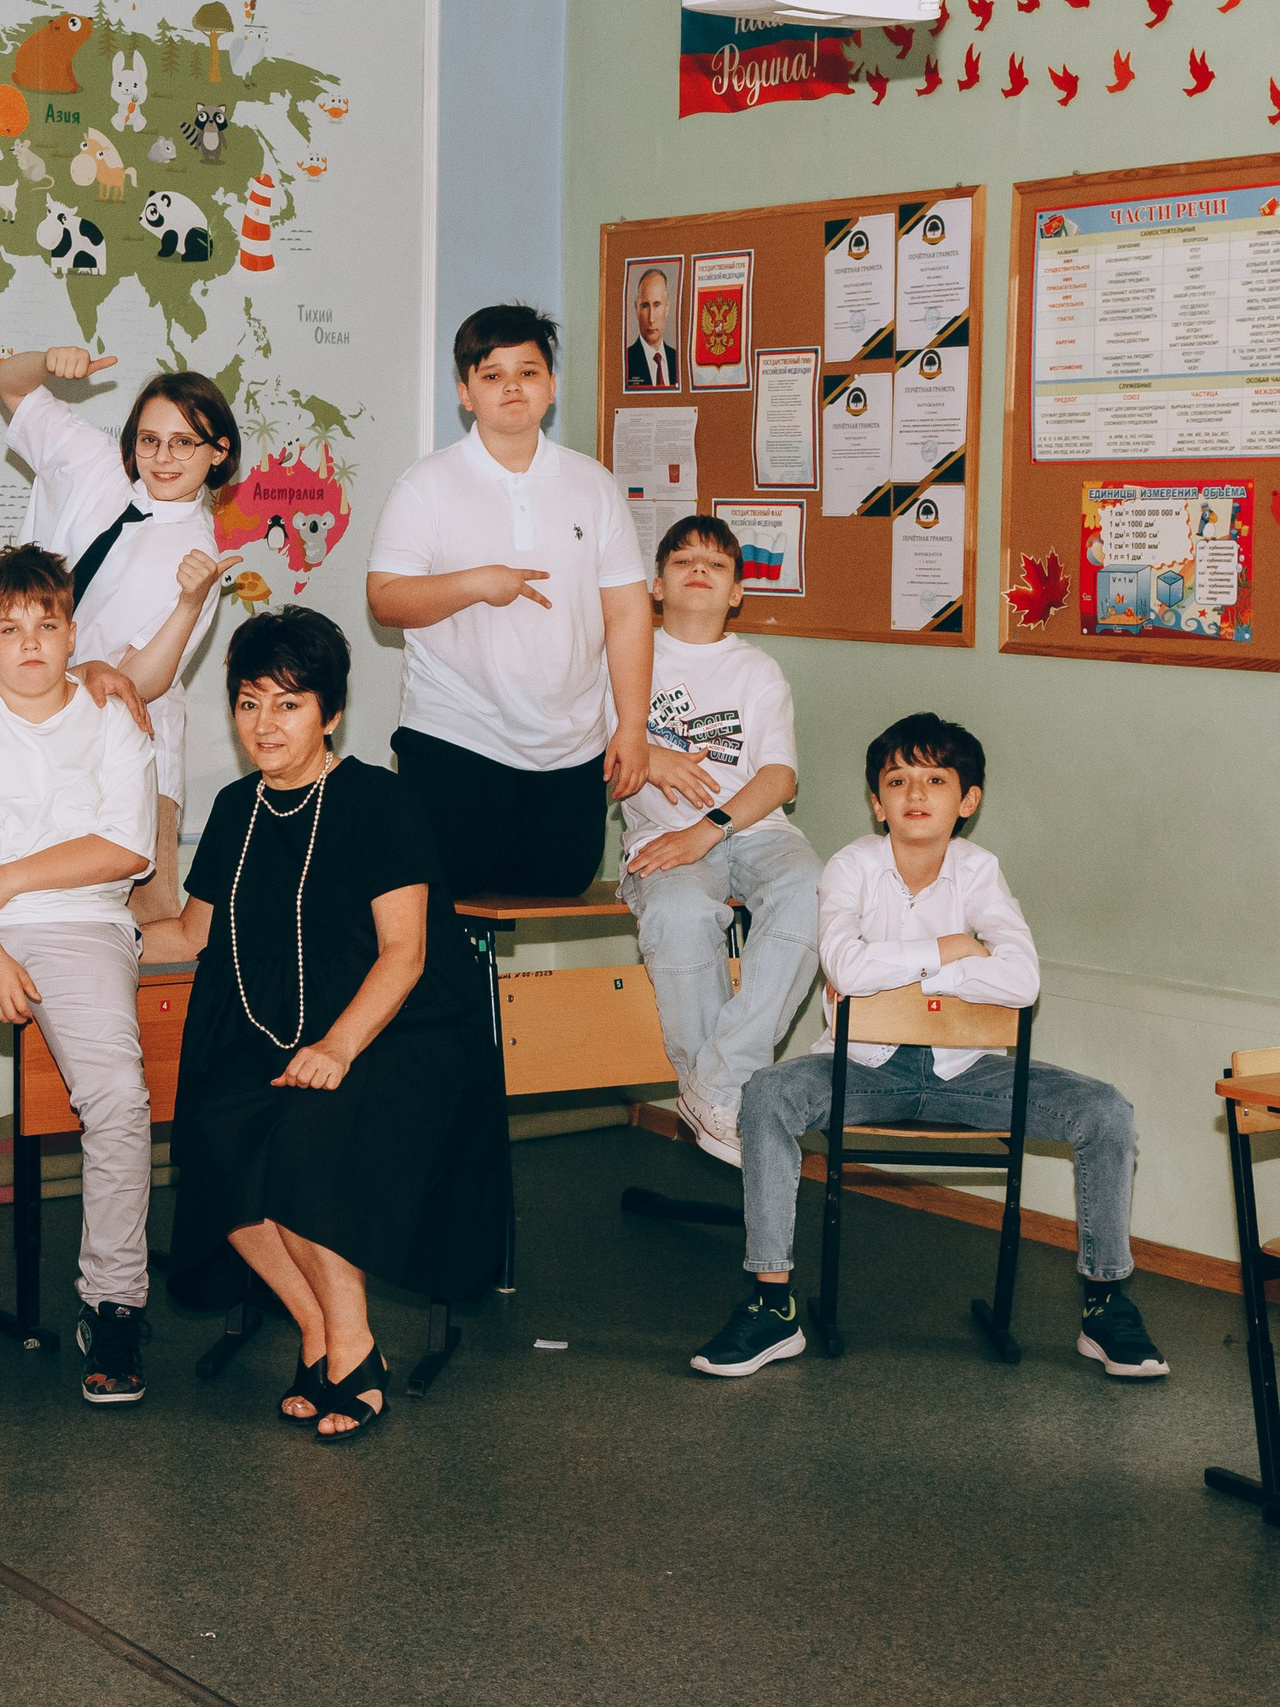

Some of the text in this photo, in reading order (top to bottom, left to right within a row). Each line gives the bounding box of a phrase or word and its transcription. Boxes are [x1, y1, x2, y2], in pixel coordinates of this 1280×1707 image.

[712, 32, 818, 106] Родина!
[45, 104, 80, 125] Азия
[1110, 198, 1228, 225] ЧАСТИ РЕЧИ
[1119, 382, 1152, 390] СЛУЖЕБНЫЕ
[253, 481, 324, 505] Австралия
[1089, 484, 1247, 500] ЕДИНИЦЫ ИЗМЕРЕНИЯ ОБЪЁМА
[1131, 509, 1146, 517] 1000
[1147, 509, 1160, 517] 000
[1161, 509, 1173, 517] 000
[1128, 520, 1143, 528] 1000
[1131, 531, 1147, 539] 1000
[1131, 542, 1147, 550] 1000
[693, 712, 735, 741] GOLF
[703, 722, 723, 732] LACOSTE
